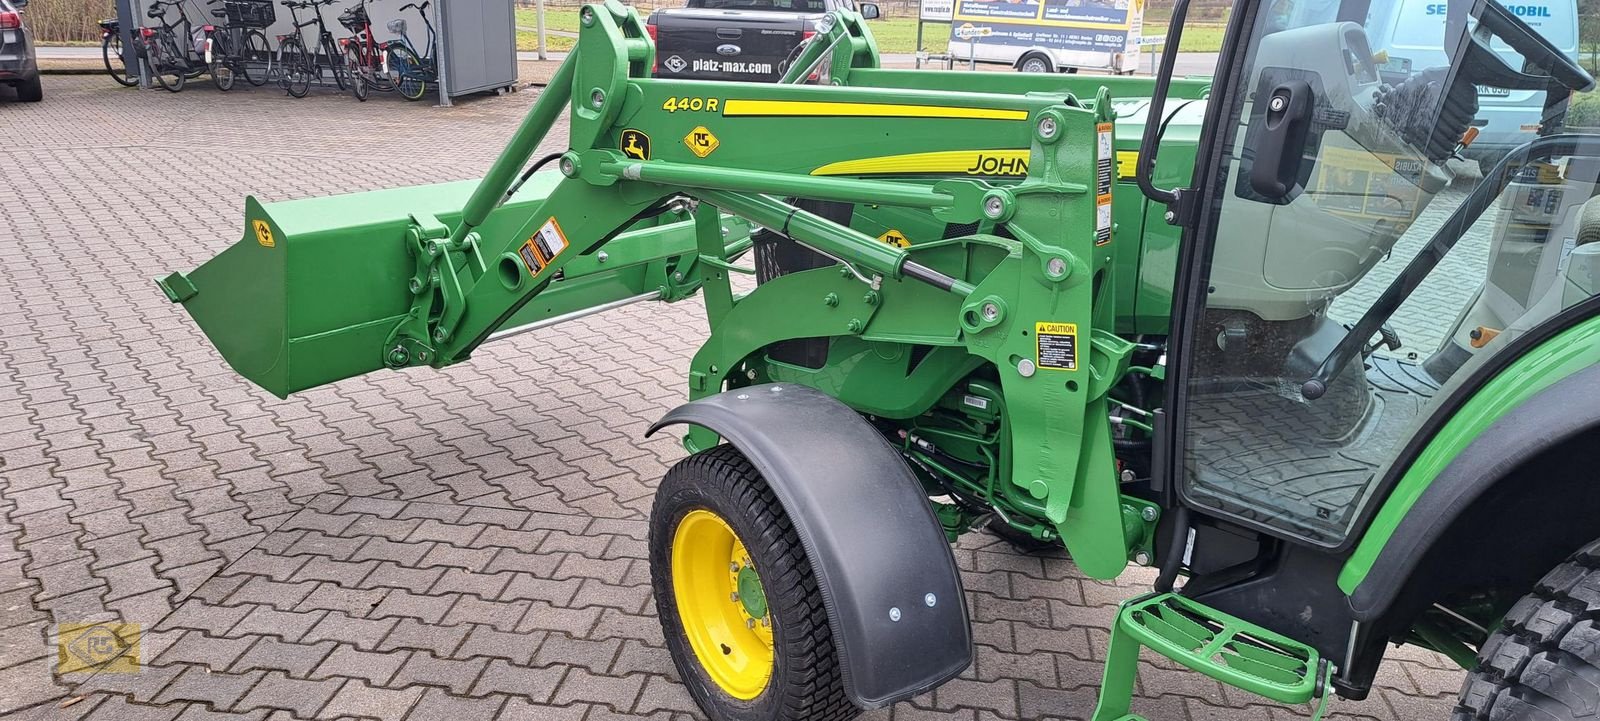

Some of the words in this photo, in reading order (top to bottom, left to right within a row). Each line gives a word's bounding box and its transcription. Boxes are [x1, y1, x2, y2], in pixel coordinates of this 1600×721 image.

[692, 59, 772, 74] platz-max.com
[663, 97, 703, 112] 440
[706, 98, 719, 112] R
[1047, 324, 1075, 333] CAUTION
